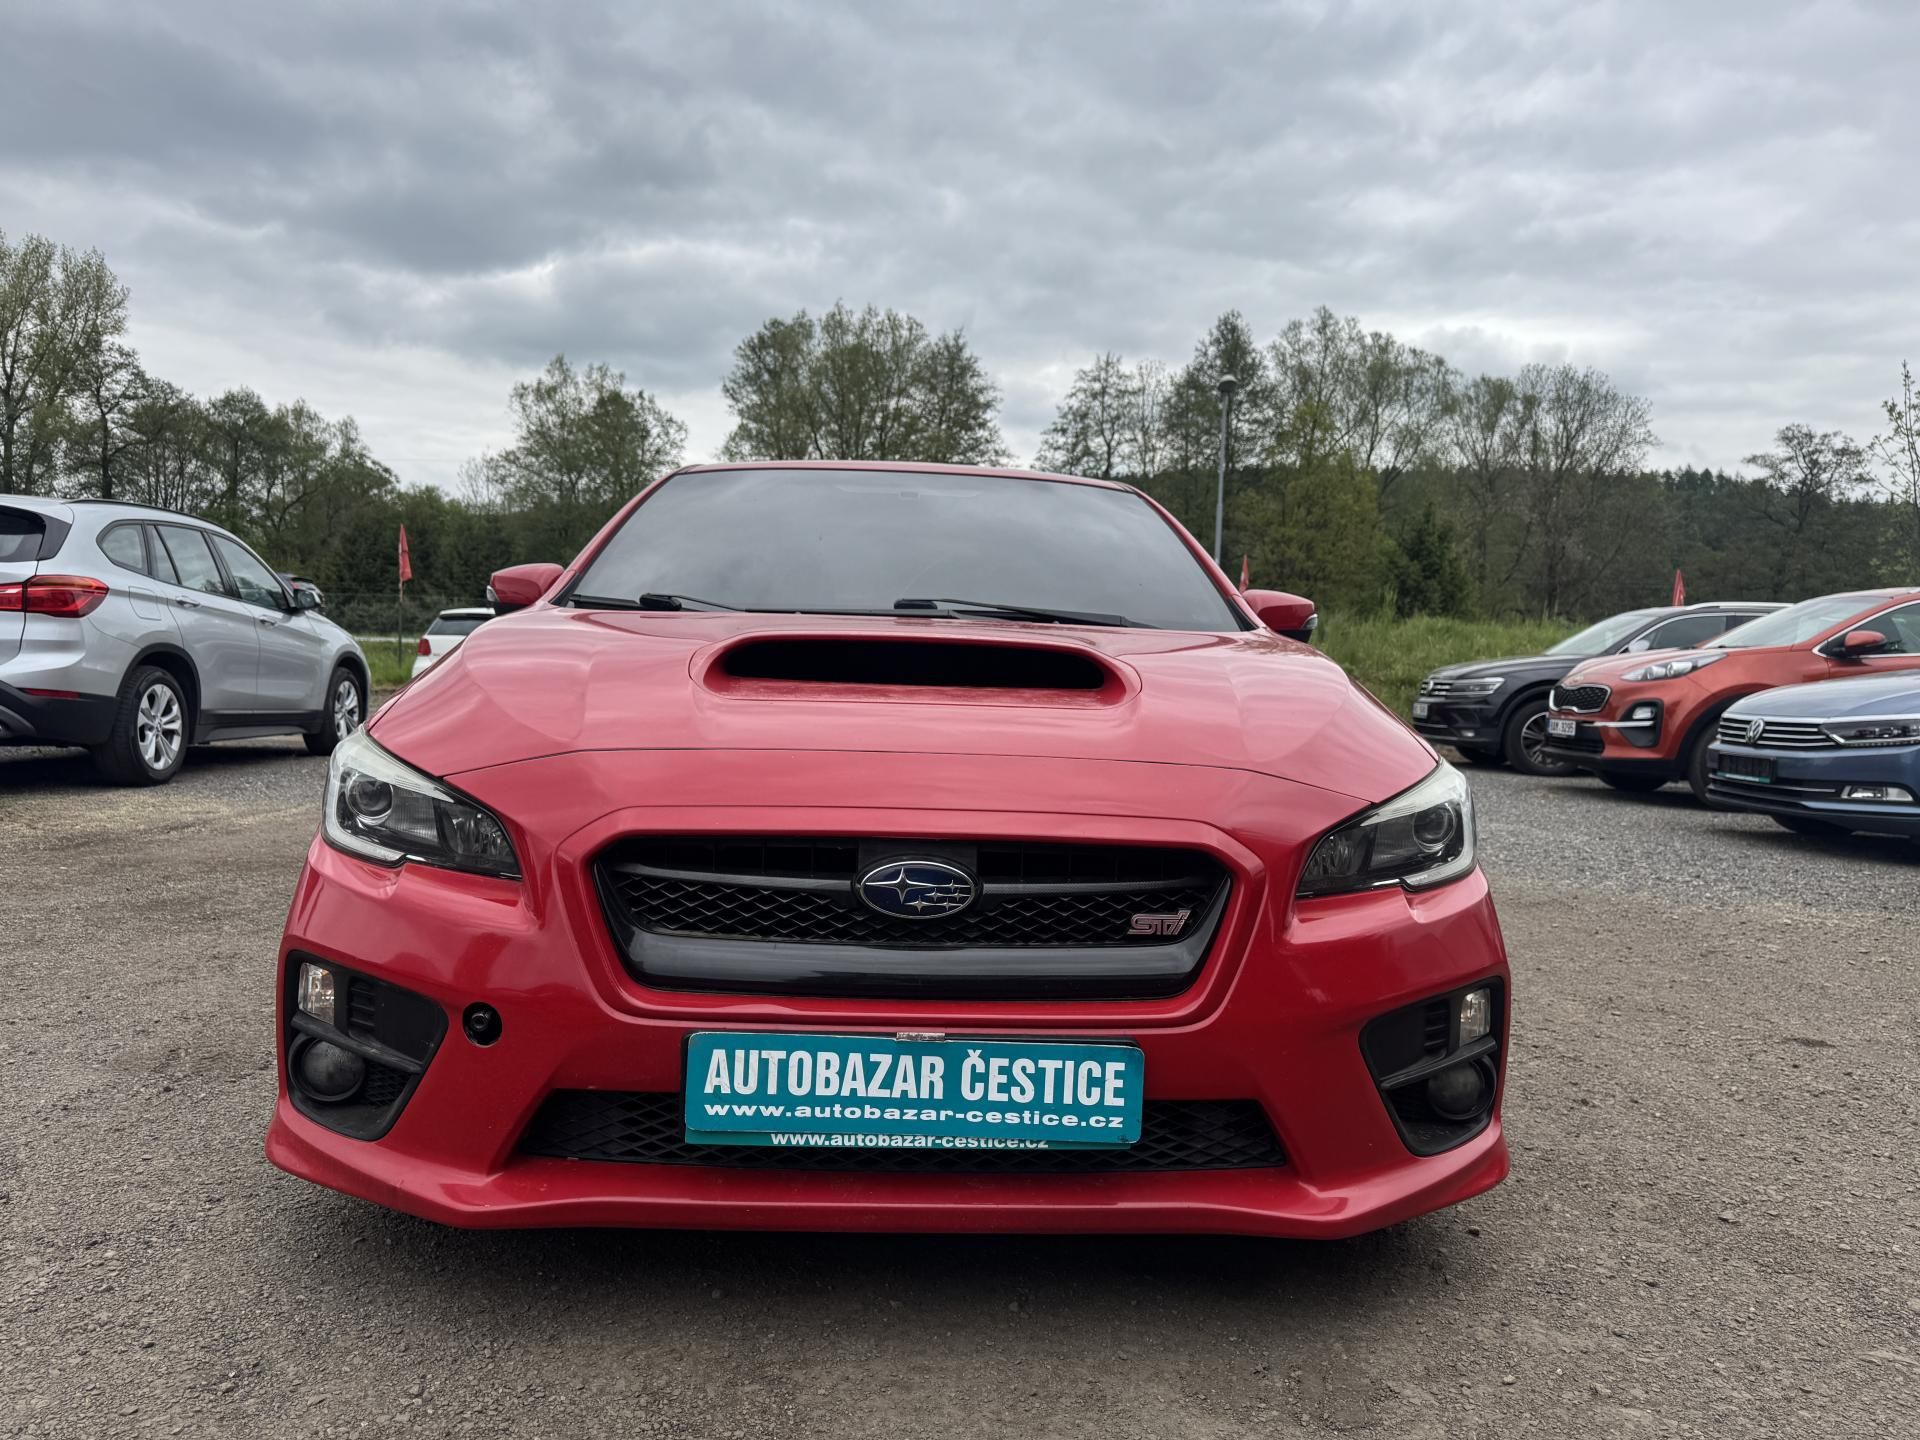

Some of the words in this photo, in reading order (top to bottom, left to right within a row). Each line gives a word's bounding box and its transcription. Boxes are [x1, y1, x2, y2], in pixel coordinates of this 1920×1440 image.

[703, 1048, 945, 1100] AUTOBAZAR
[960, 1049, 1126, 1107] ČESTICE
[703, 1103, 1125, 1129] www.autobazar-cestice.cz
